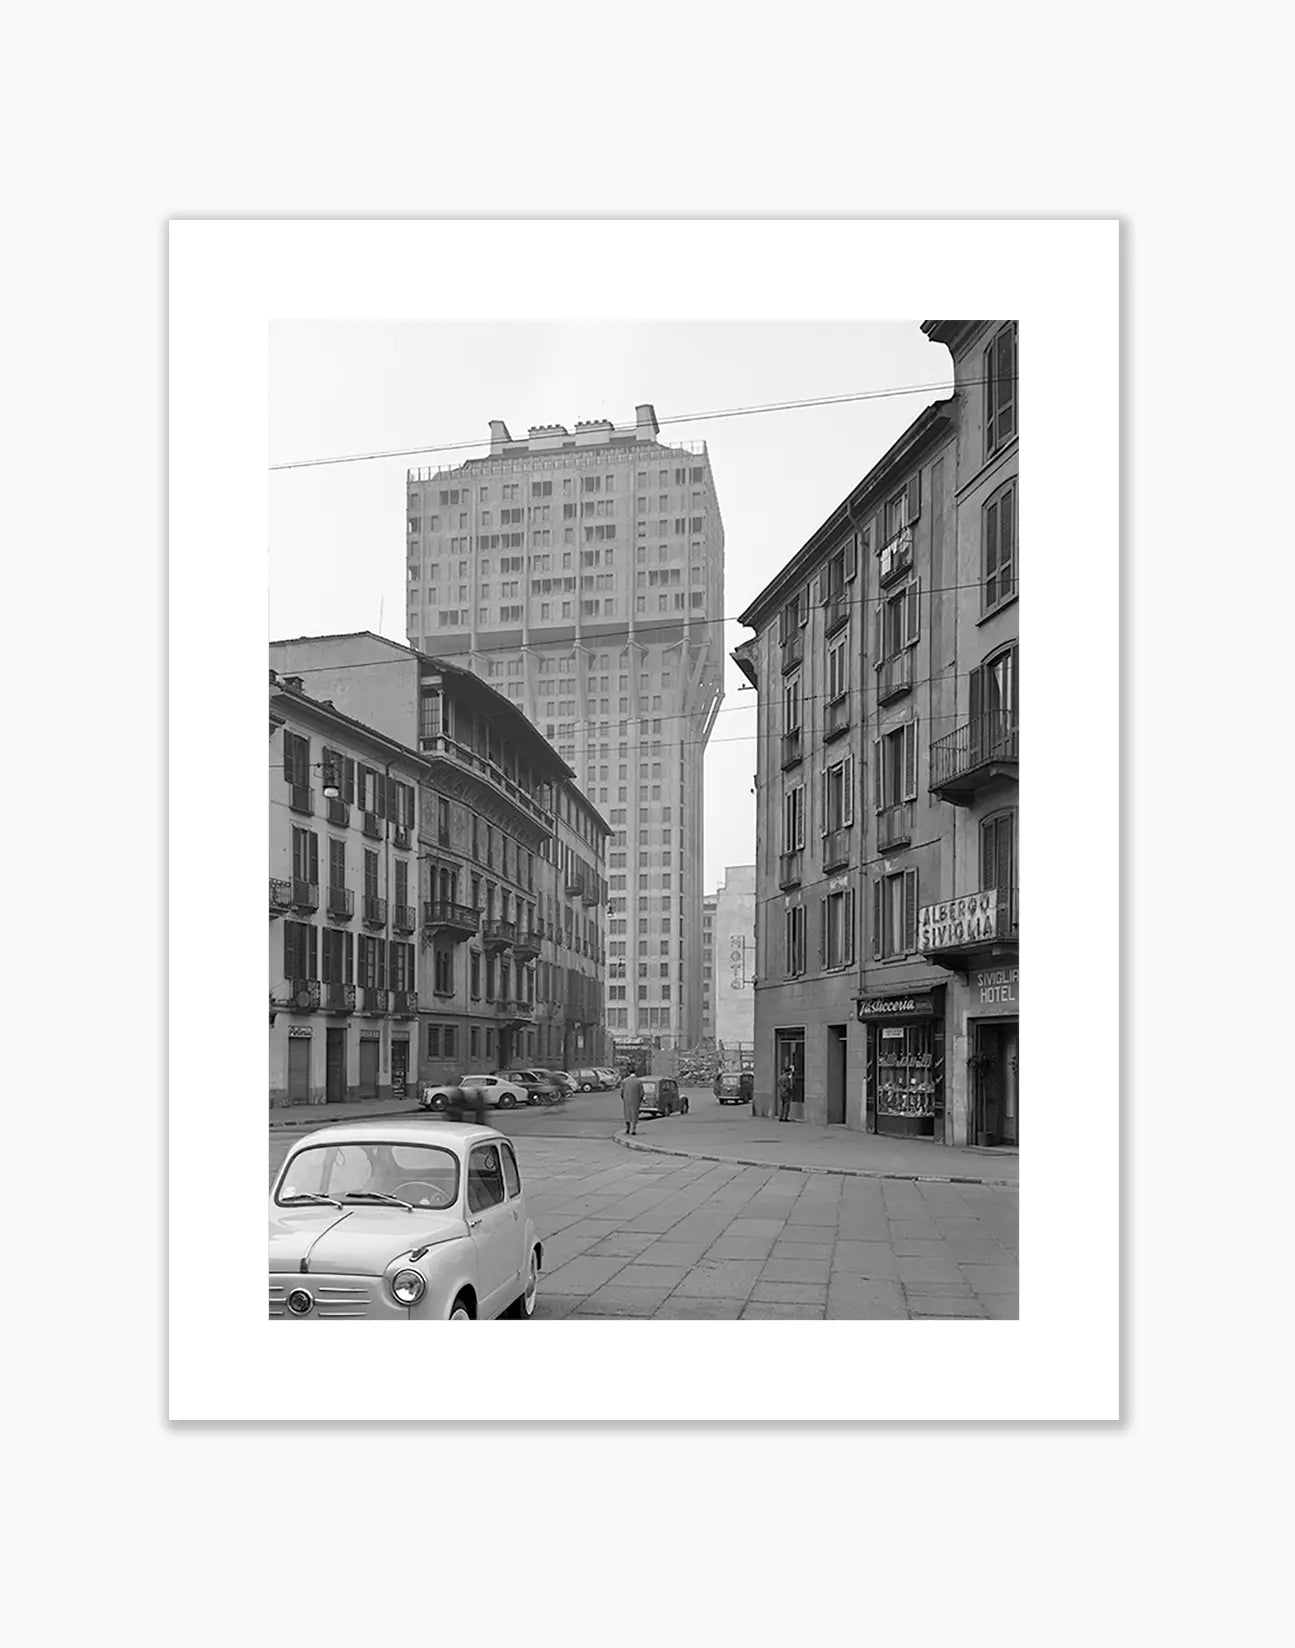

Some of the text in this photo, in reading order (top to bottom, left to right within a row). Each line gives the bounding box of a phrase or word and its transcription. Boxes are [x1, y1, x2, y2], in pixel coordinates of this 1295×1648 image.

[922, 895, 991, 928] ALBERGO
[922, 915, 994, 947] SIVIGLIA
[977, 968, 1019, 987] SIVIGLIA
[980, 985, 1016, 1004] HOTEL
